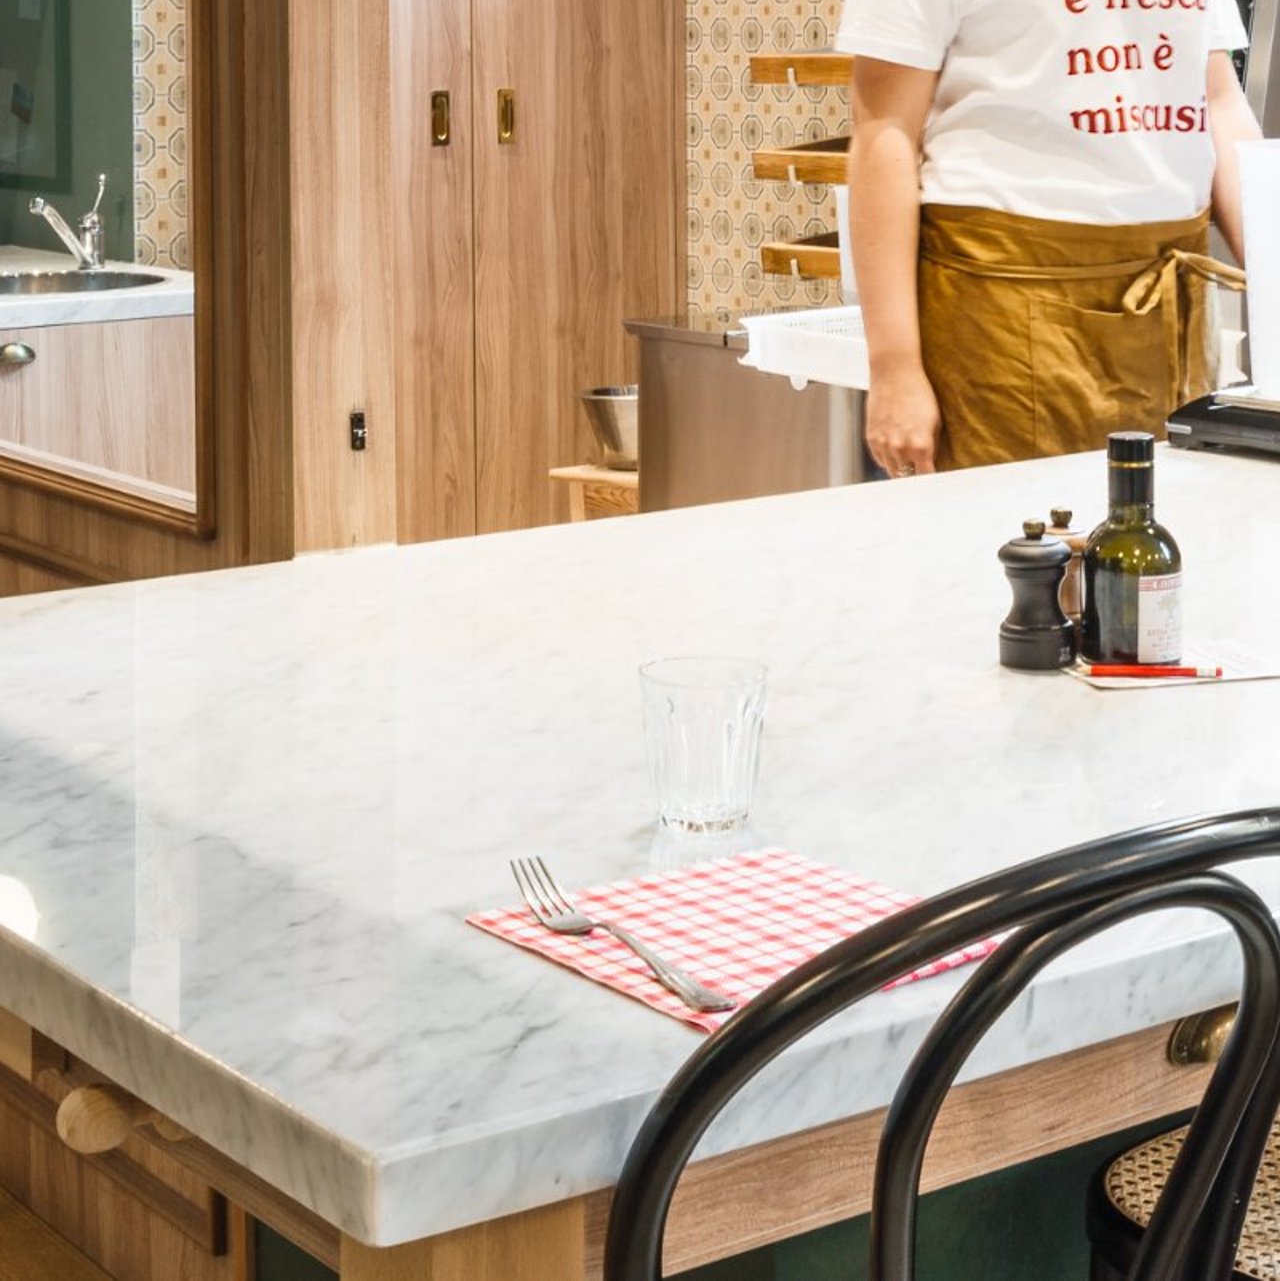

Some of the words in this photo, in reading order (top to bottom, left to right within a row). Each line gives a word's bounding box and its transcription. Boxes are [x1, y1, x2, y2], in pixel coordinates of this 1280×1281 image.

[1066, 42, 1143, 77] non
[1152, 32, 1174, 72] è
[1070, 94, 1207, 135] miscusi
